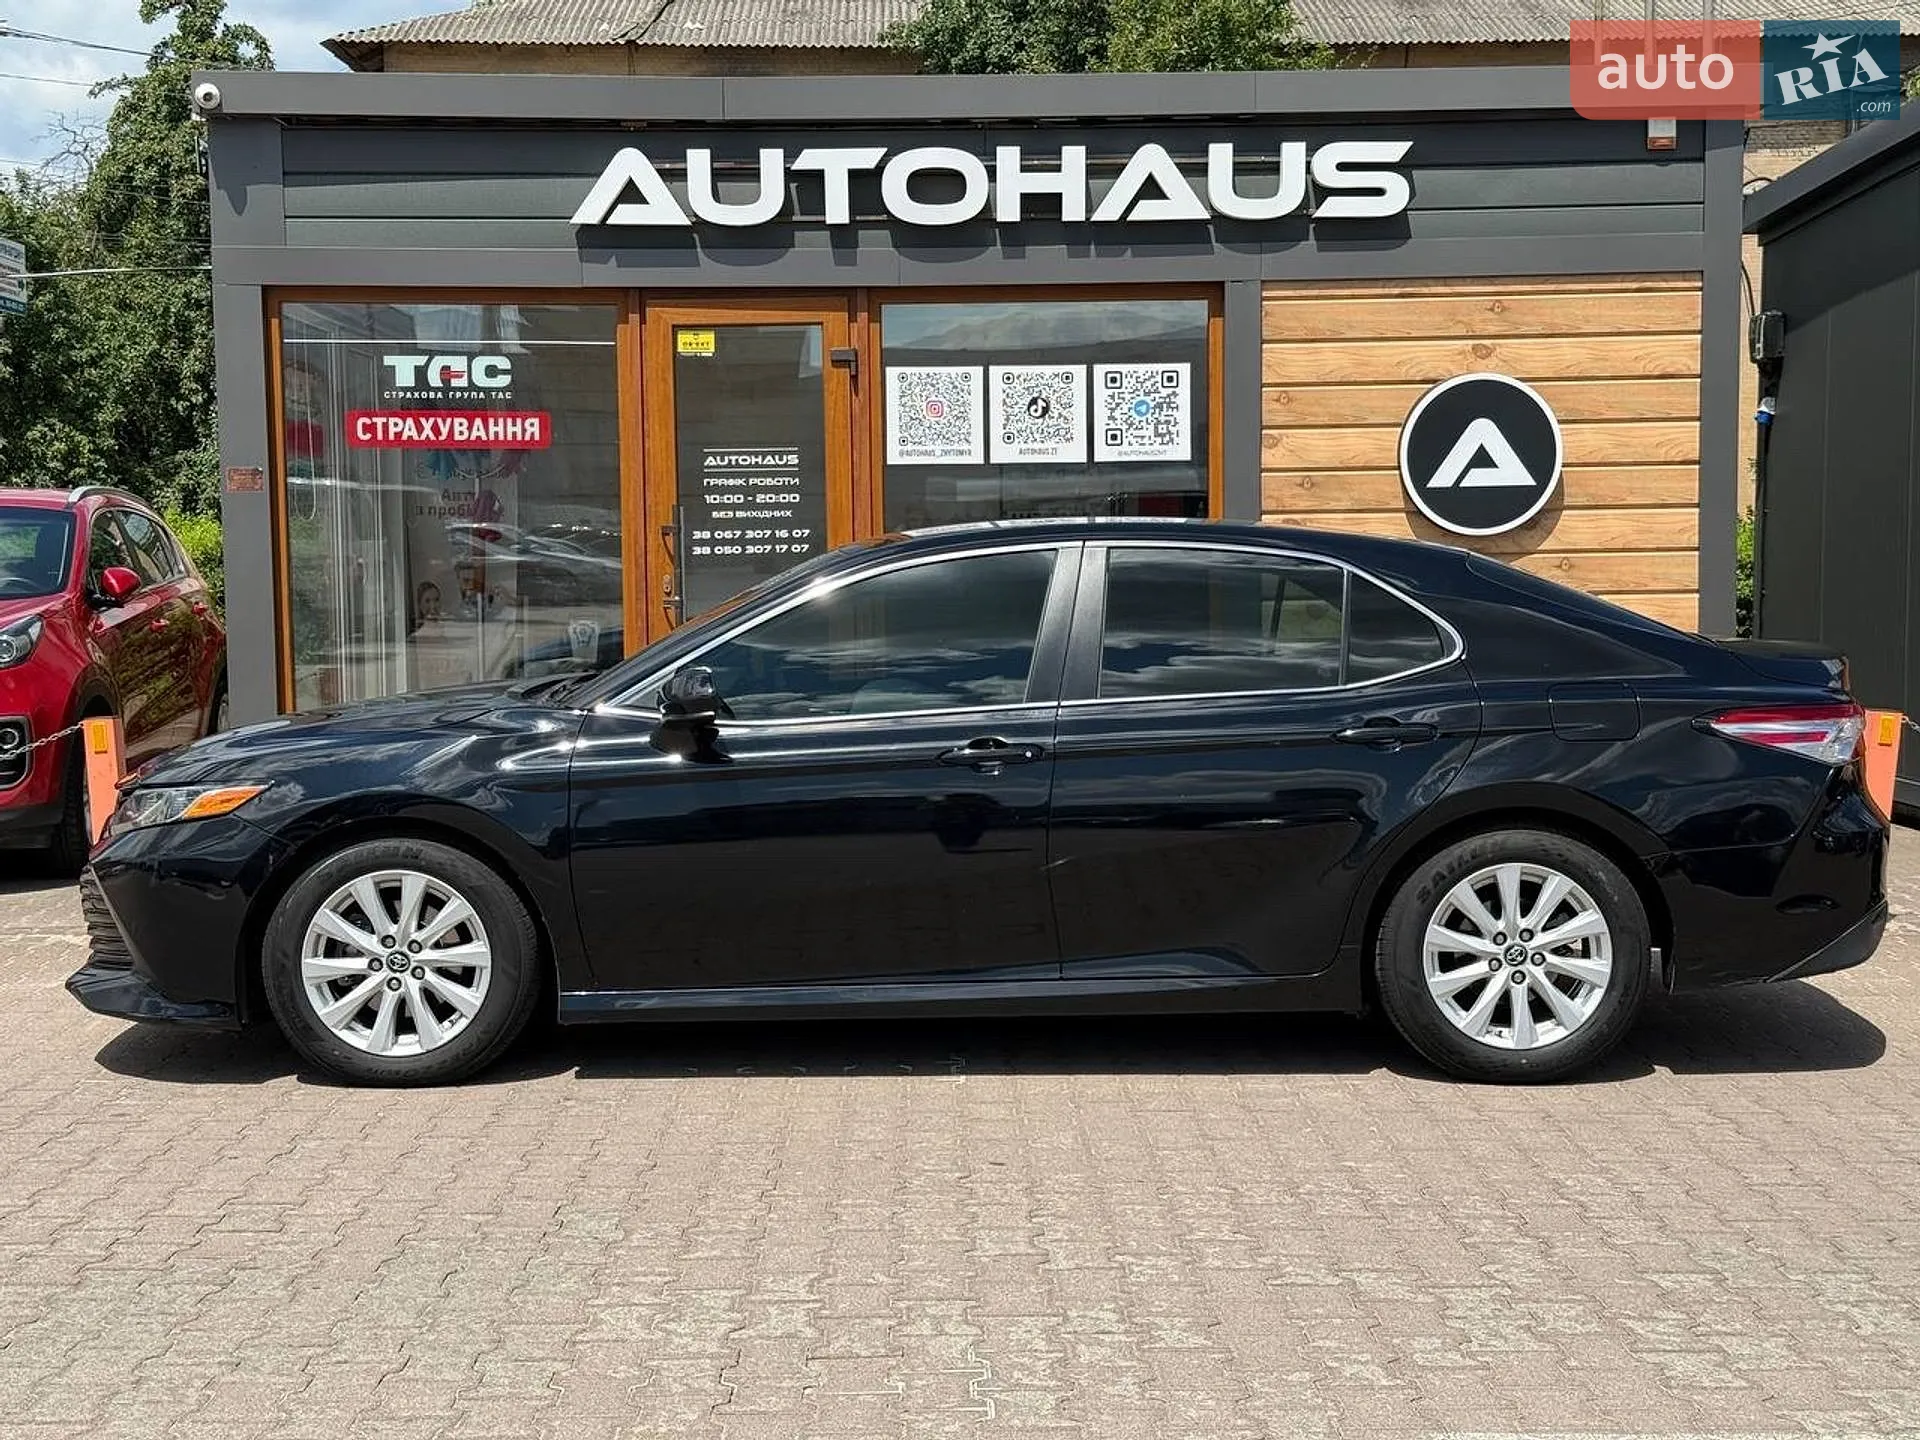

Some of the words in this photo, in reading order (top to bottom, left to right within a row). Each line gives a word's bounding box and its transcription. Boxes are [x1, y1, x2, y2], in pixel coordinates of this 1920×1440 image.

[569, 141, 1413, 227] AUTOHAUS
[383, 355, 512, 388] ТАС
[384, 391, 443, 399] СТРАХОВА
[449, 391, 485, 399] ГРУПА
[491, 391, 513, 399] ТАС
[356, 416, 540, 441] СТРАХУВАННЯ
[704, 454, 799, 466] AUTOHAUS
[704, 478, 747, 486] ГРАФІК
[749, 477, 799, 486] РОБОТИ
[704, 494, 744, 504] 10:00
[756, 493, 800, 503] 20:00
[735, 509, 792, 518] ВИХІДНИХ
[692, 530, 711, 539] 38
[714, 530, 742, 539] 067
[745, 530, 772, 539] 307
[775, 529, 789, 538] 16
[792, 529, 810, 538] 07
[692, 546, 711, 555] 38
[714, 545, 742, 554] 050
[745, 544, 772, 554] 307
[775, 544, 789, 553] 17
[791, 544, 810, 553] 07
